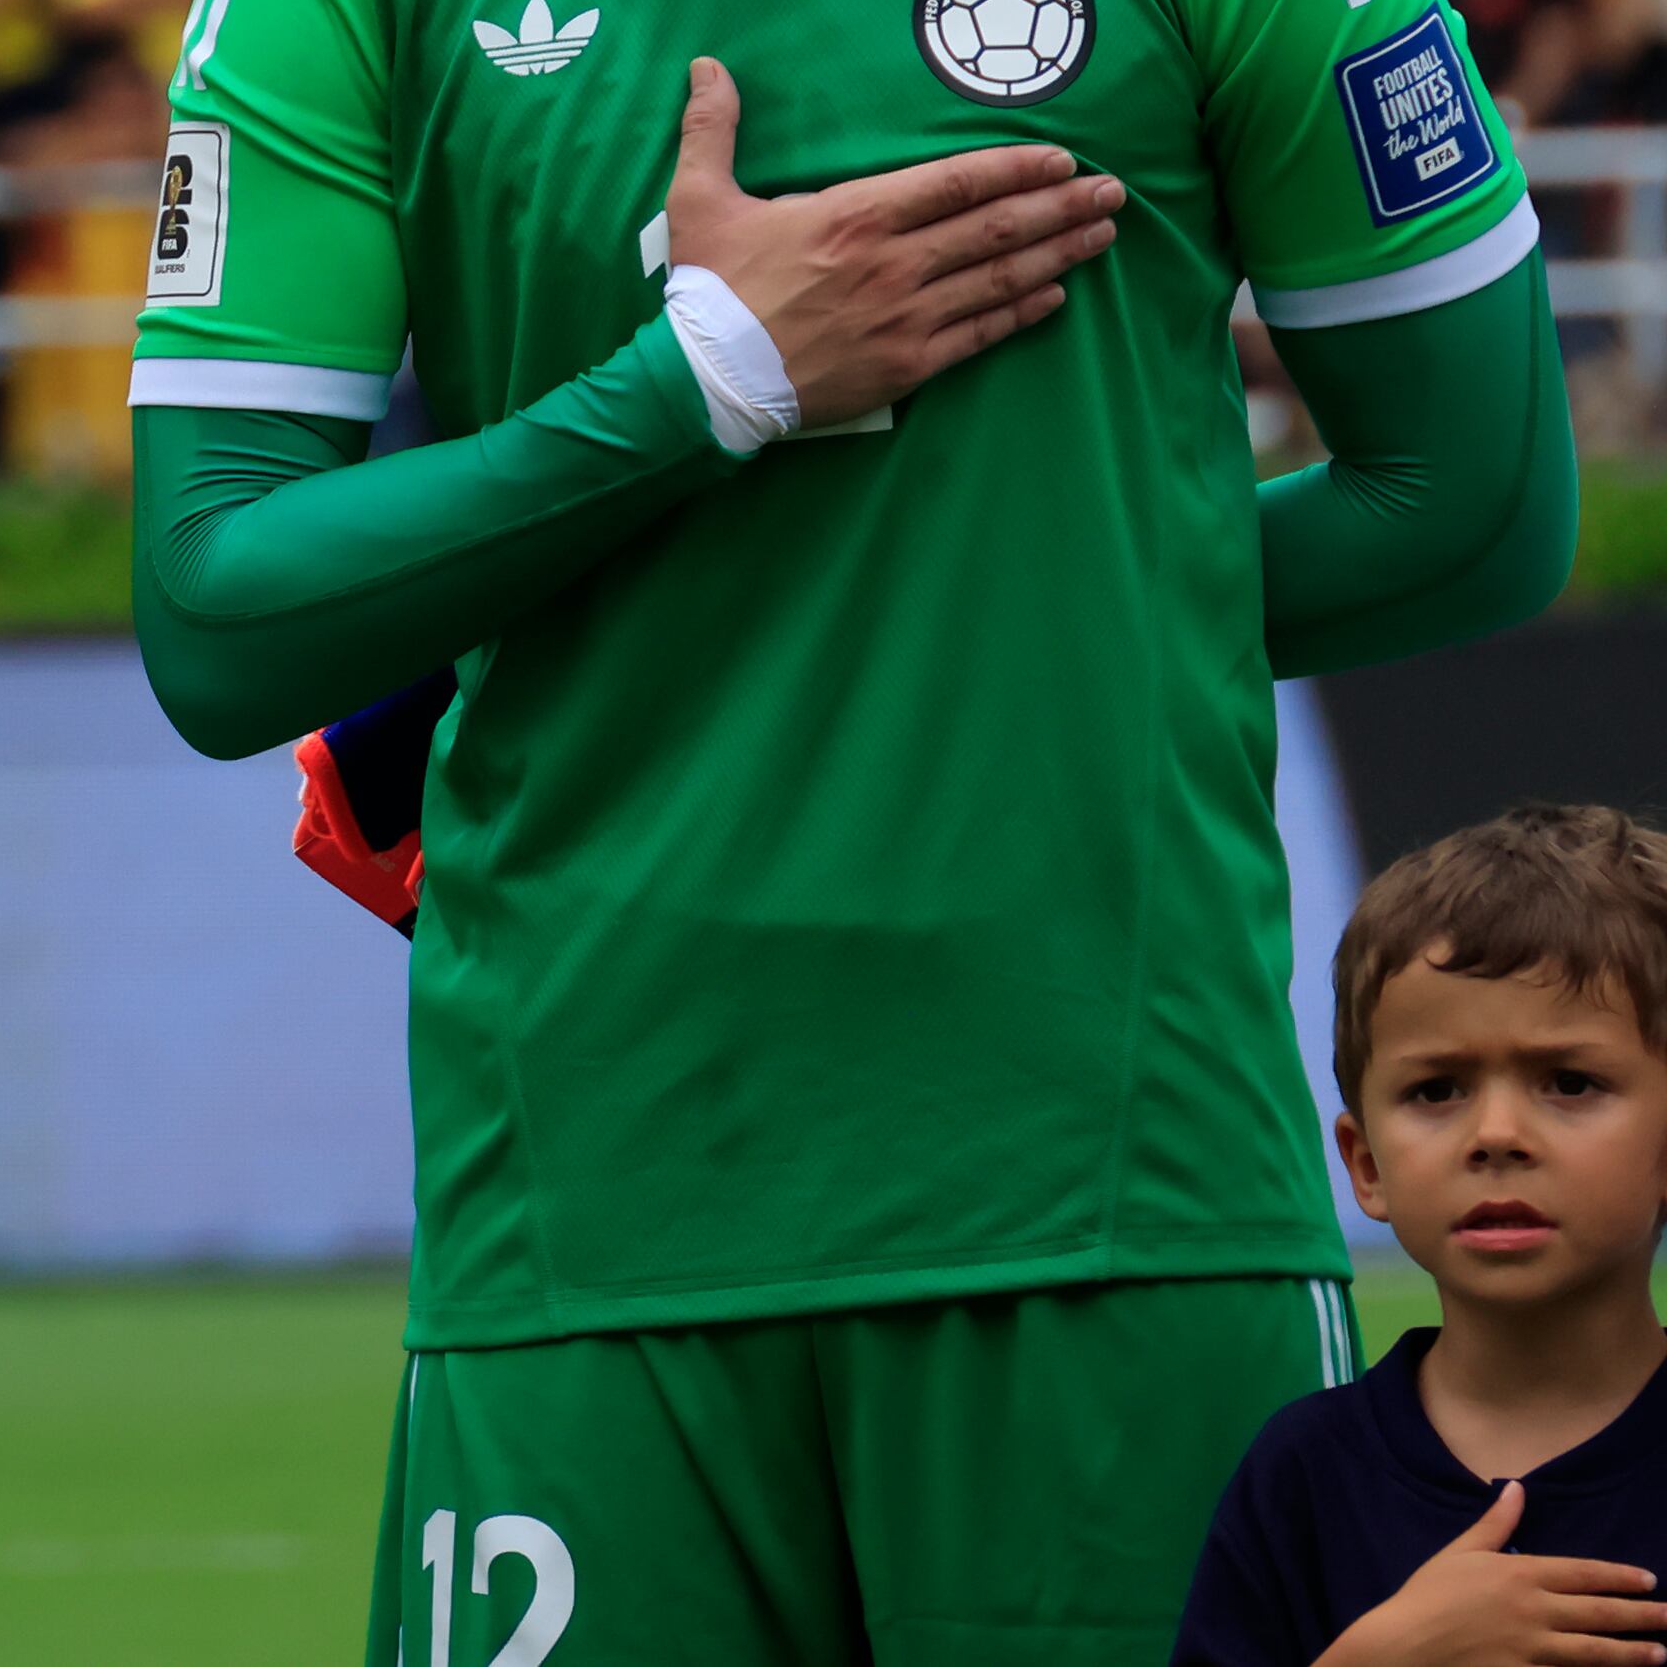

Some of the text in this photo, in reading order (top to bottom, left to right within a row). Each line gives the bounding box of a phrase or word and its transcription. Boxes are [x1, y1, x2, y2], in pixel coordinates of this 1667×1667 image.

[1373, 45, 1443, 100] FOOTBALL
[1379, 67, 1454, 131] UNITES
[1383, 95, 1466, 161] the World
[1423, 147, 1455, 172] FIFA
[420, 1507, 576, 1667] 12
